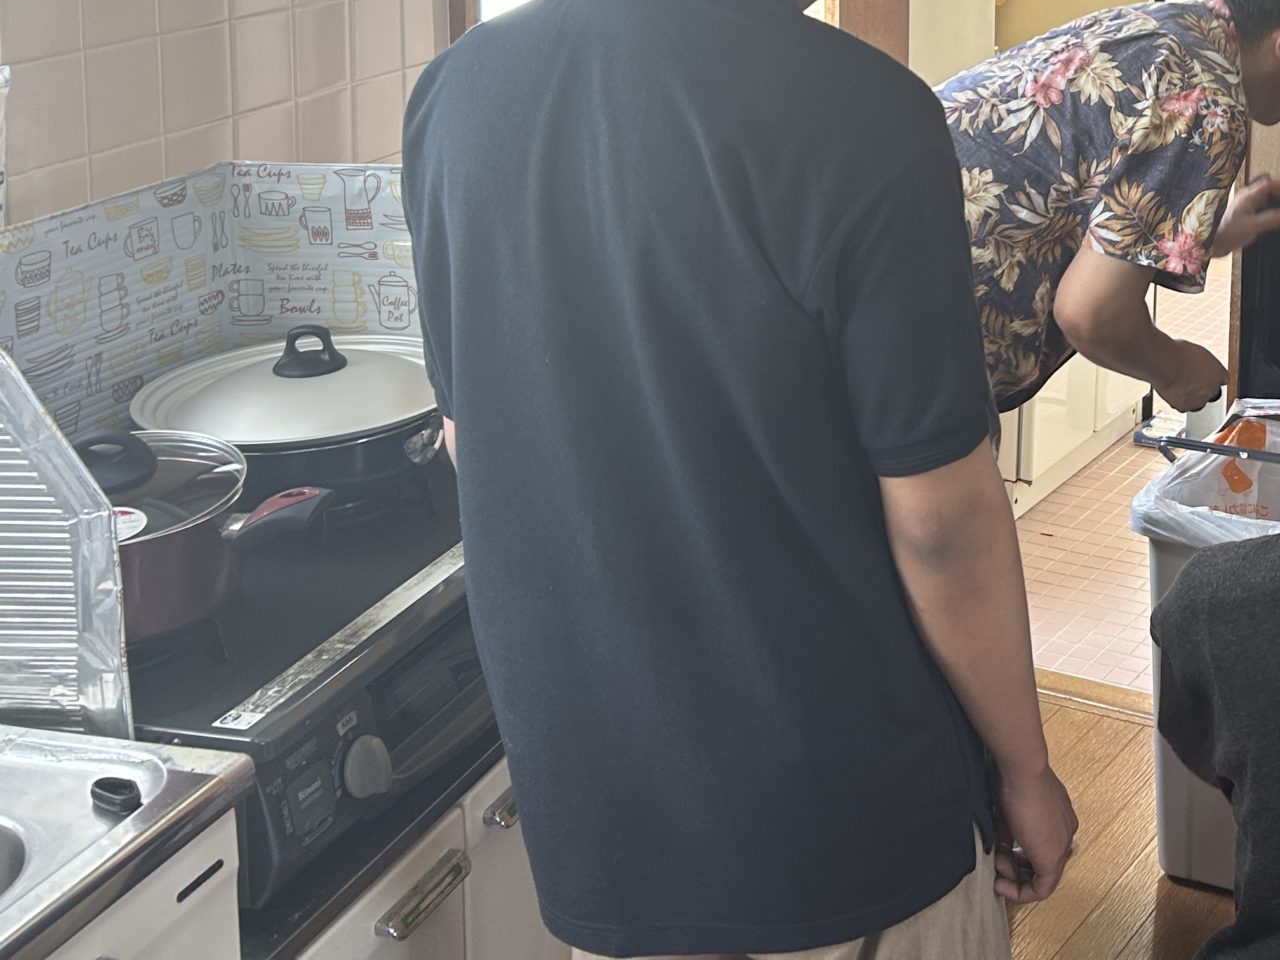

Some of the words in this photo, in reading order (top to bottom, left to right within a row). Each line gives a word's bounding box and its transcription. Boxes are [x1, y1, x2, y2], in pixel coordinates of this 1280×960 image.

[231, 164, 252, 178] Tea
[256, 163, 292, 184] Cups
[62, 240, 83, 258] Tea
[87, 231, 119, 251] Cups
[279, 297, 322, 315] Bowls
[382, 296, 409, 311] Coffee
[387, 310, 404, 322] Pot
[169, 318, 199, 337] Cups
